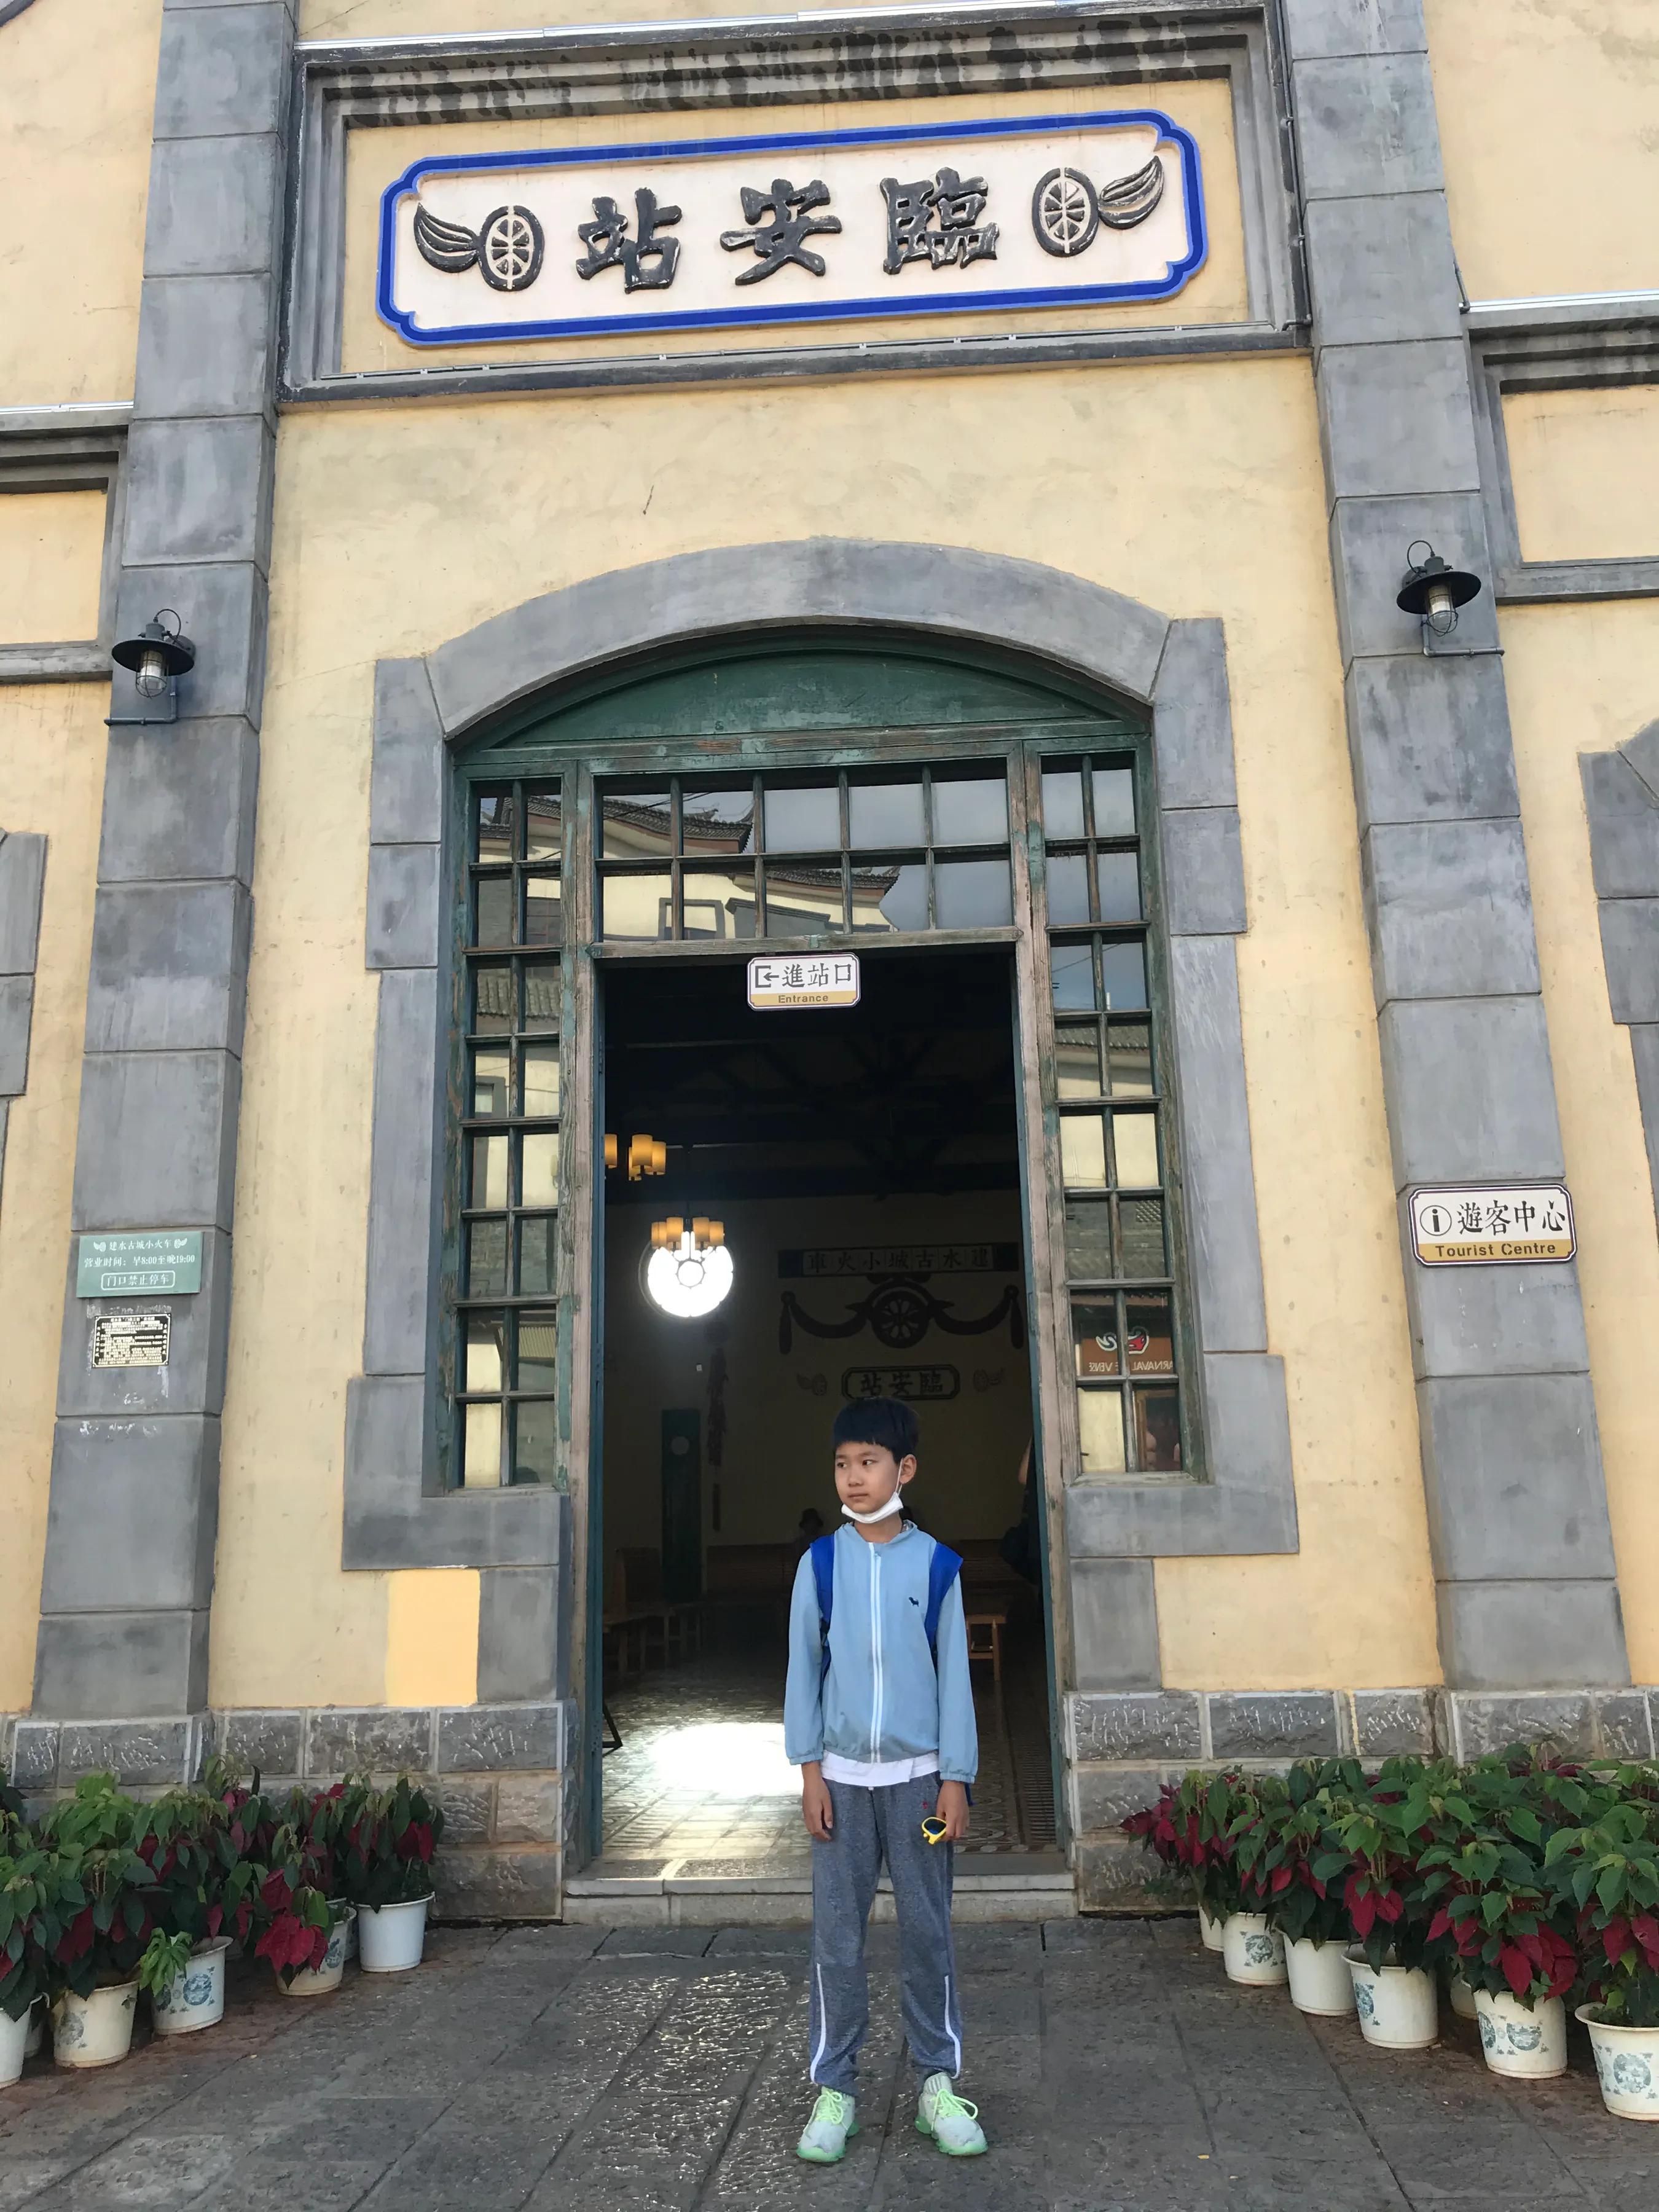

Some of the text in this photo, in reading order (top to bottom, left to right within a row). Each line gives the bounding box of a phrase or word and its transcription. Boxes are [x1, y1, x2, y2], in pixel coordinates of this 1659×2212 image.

[782, 963, 852, 988] 進站口
[779, 994, 829, 1003] Entrance
[1457, 1199, 1566, 1236] 遊客中心
[109, 1239, 172, 1251] 建水古城小火车
[1435, 1242, 1556, 1257] Tourist Centre
[107, 1274, 170, 1287] 门口禁止停车
